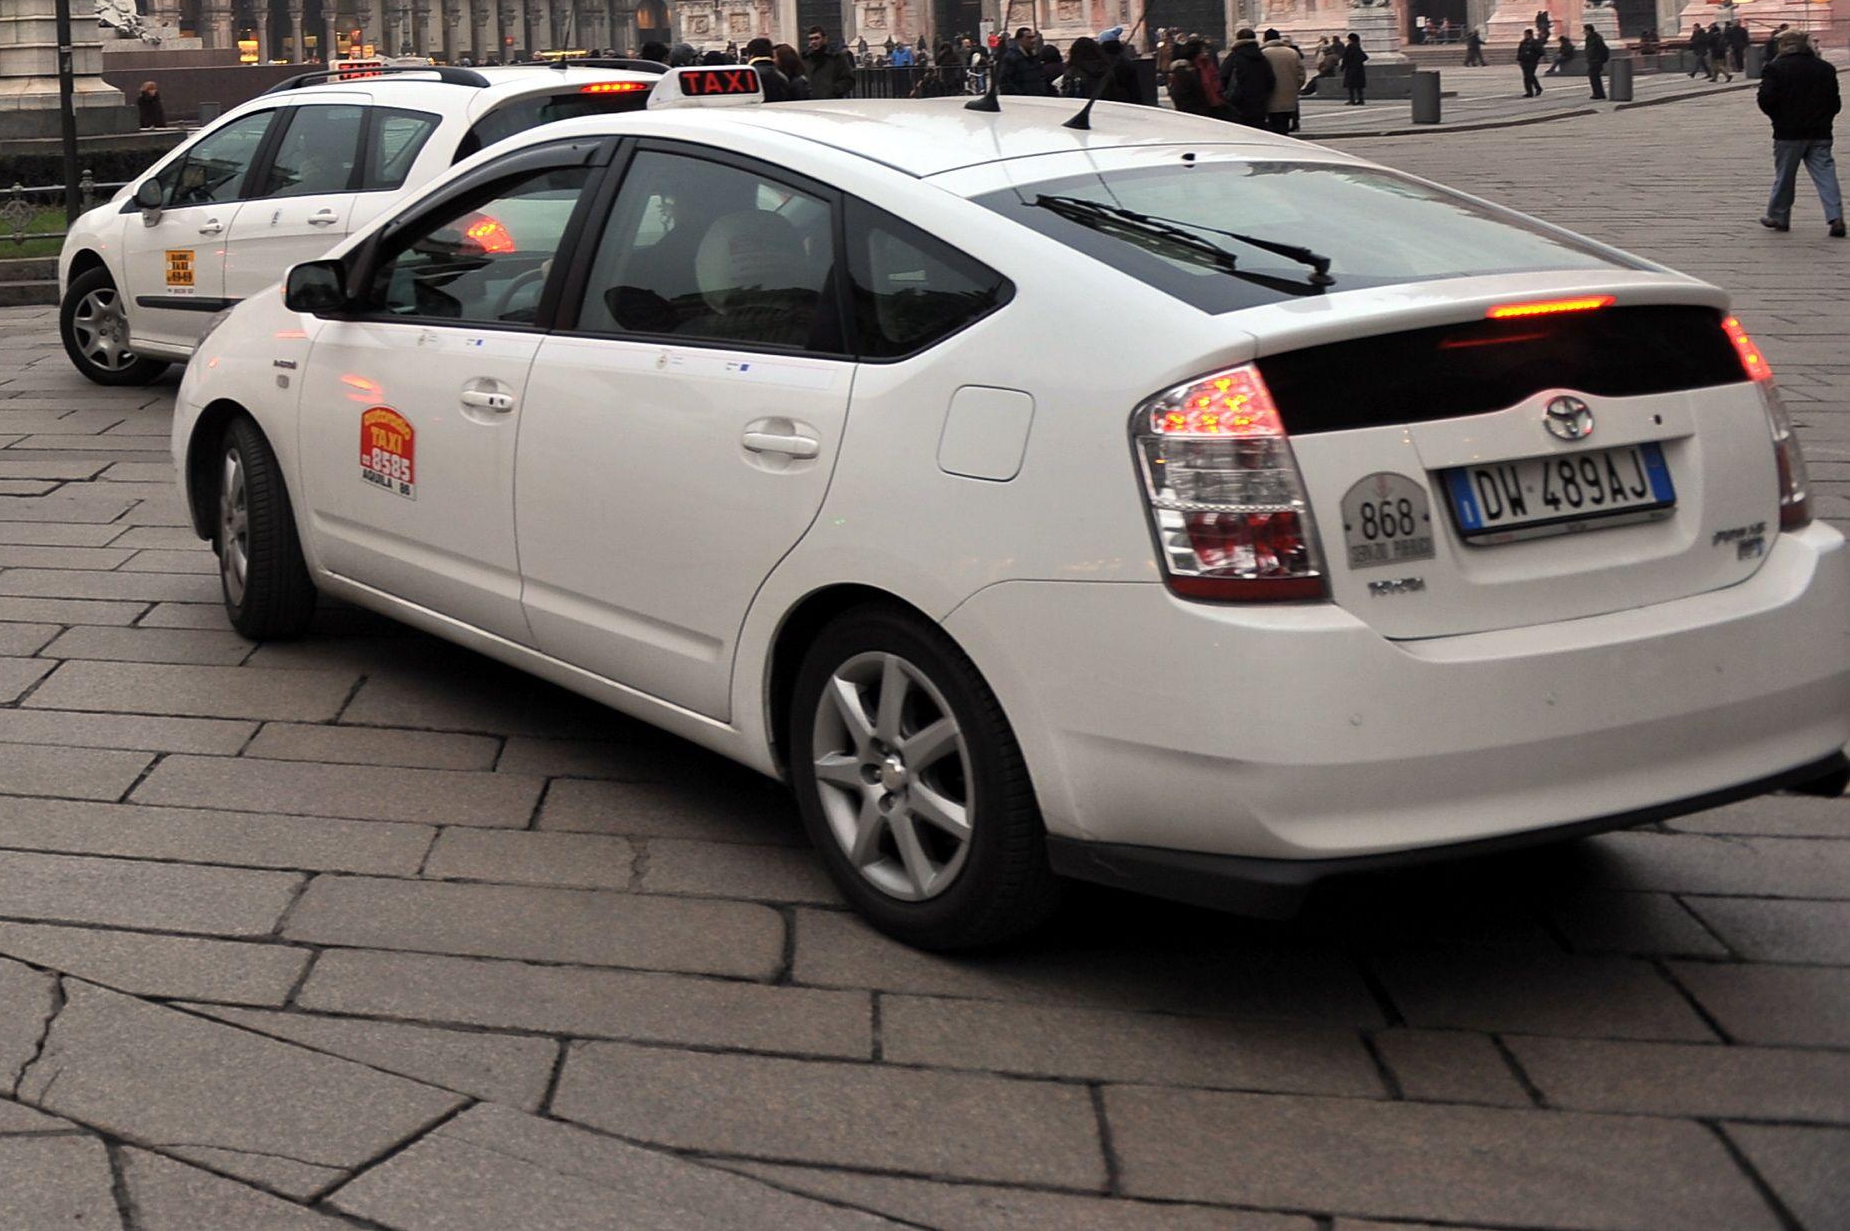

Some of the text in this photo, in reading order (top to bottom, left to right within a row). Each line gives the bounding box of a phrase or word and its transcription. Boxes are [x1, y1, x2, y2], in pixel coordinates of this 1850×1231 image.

[682, 69, 757, 94] TAXI
[370, 425, 403, 455] TAXI
[371, 447, 411, 482] 8585
[1476, 449, 1648, 521] DW 489AJ
[1361, 498, 1415, 540] 868
